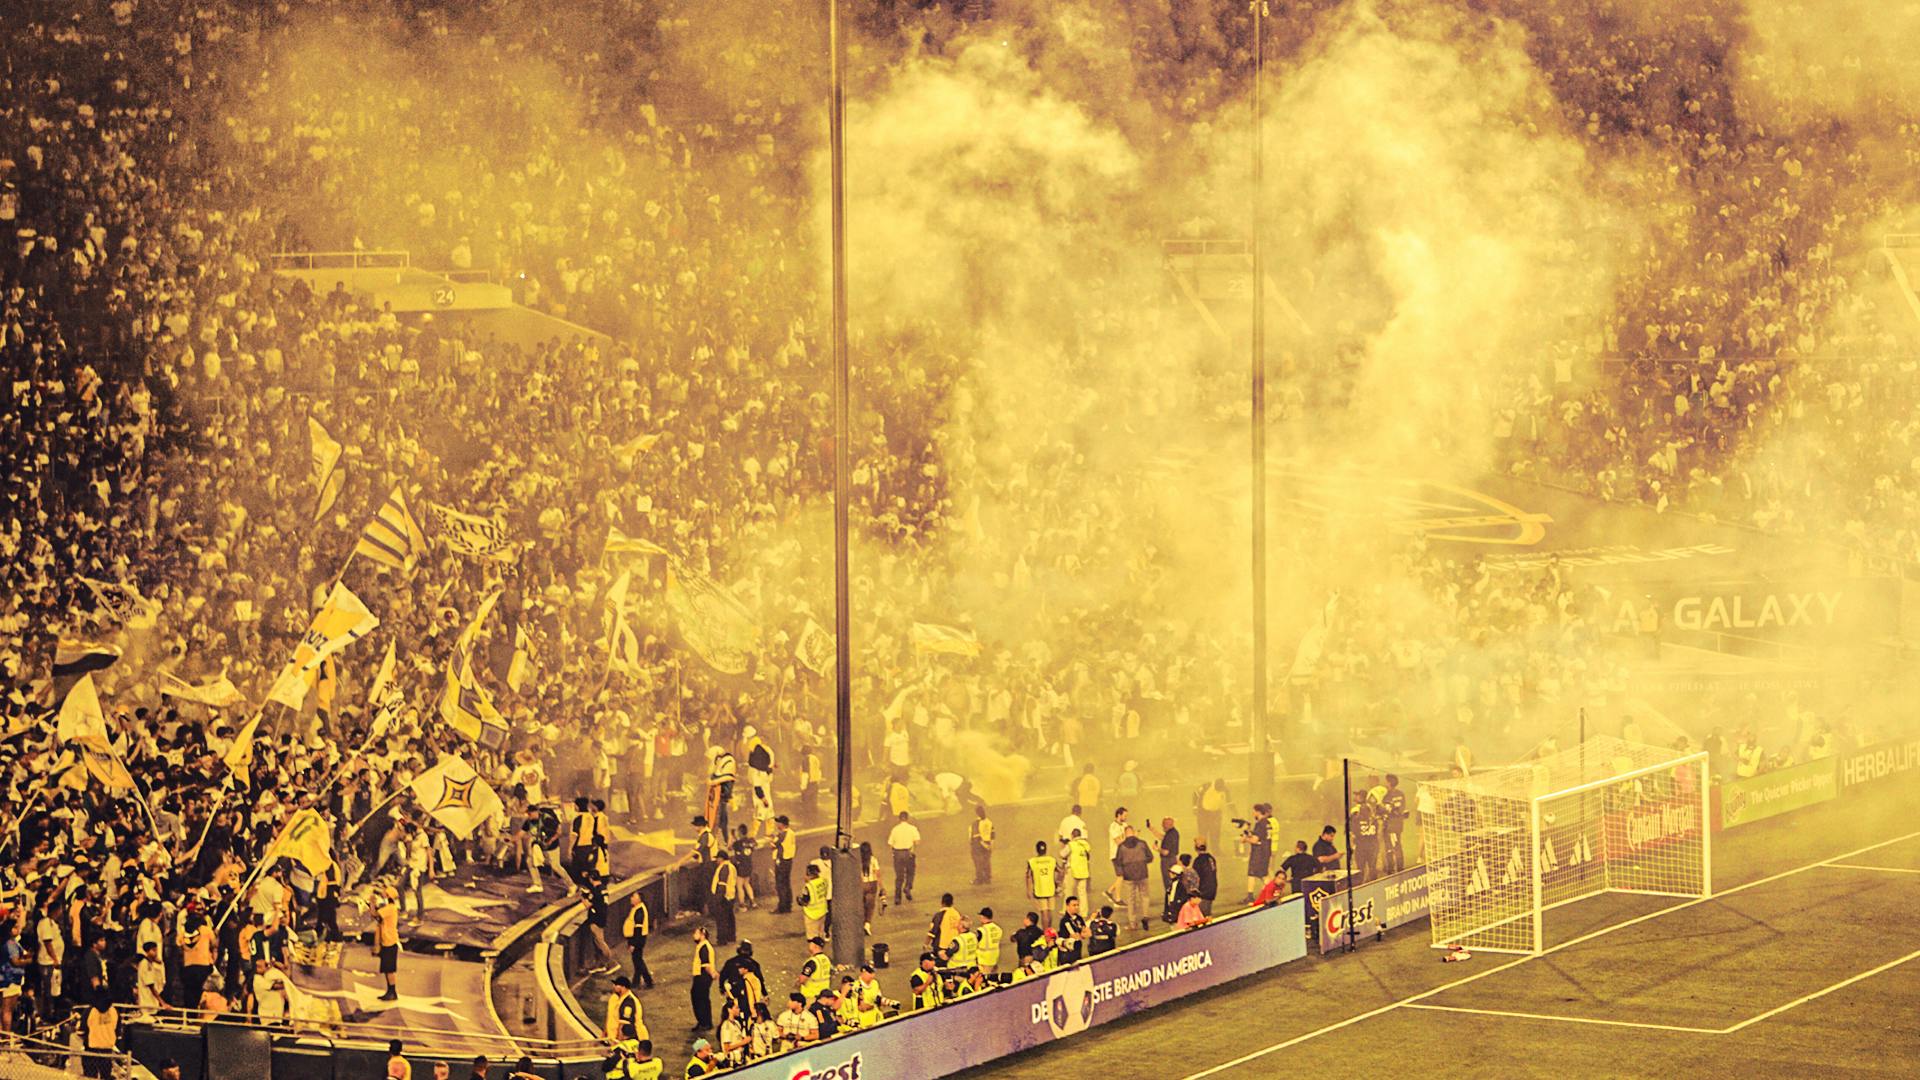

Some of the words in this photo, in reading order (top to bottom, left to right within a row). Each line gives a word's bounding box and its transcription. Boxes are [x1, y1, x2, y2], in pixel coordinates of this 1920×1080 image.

[437, 289, 454, 304] 24
[1674, 592, 1842, 630] GALAXY
[1627, 811, 1660, 850] Captain
[1661, 803, 1694, 839] Morgan
[1384, 883, 1400, 901] THE
[1327, 899, 1374, 935] Crest
[1386, 900, 1411, 922] BRAND
[1114, 966, 1151, 997] BRAND
[1152, 961, 1166, 984] IN
[1166, 950, 1212, 980] AMERICA
[791, 1055, 862, 1080] est
